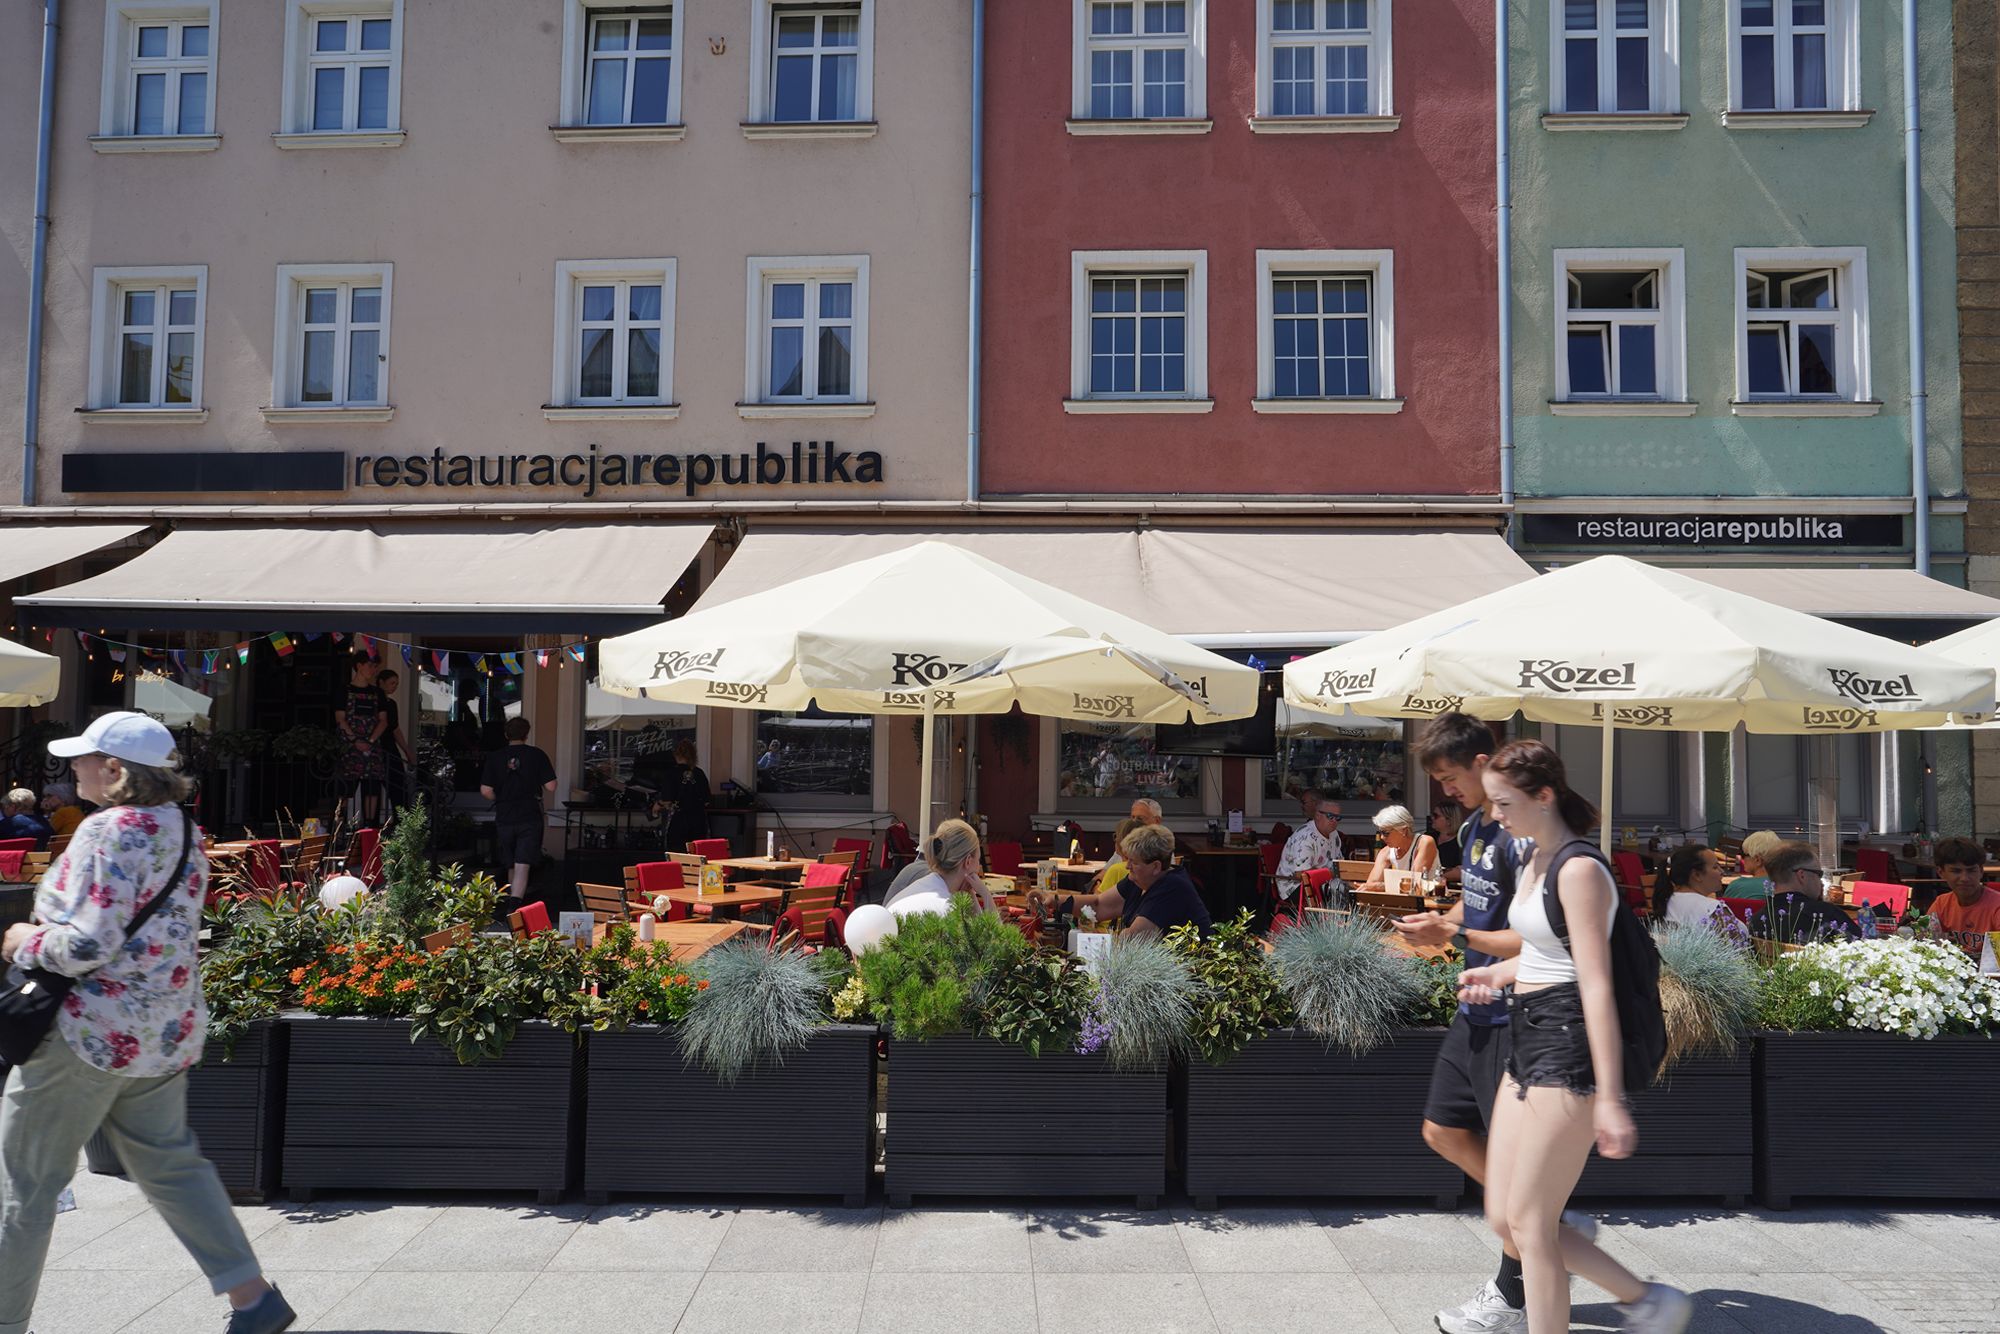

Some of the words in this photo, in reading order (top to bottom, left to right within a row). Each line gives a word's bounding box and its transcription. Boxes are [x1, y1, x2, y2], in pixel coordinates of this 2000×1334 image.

[355, 442, 883, 498] restauracjarepublika
[1577, 517, 1844, 543] restauracjarepublika
[649, 648, 726, 679] Kozel
[891, 653, 968, 687] Koz
[1517, 660, 1637, 692] Kozel
[1317, 668, 1376, 697] Kozel
[1827, 668, 1922, 703] Kozel
[624, 728, 668, 748] PIZZA
[638, 739, 673, 756] TIME
[1136, 773, 1163, 785] LIVE
